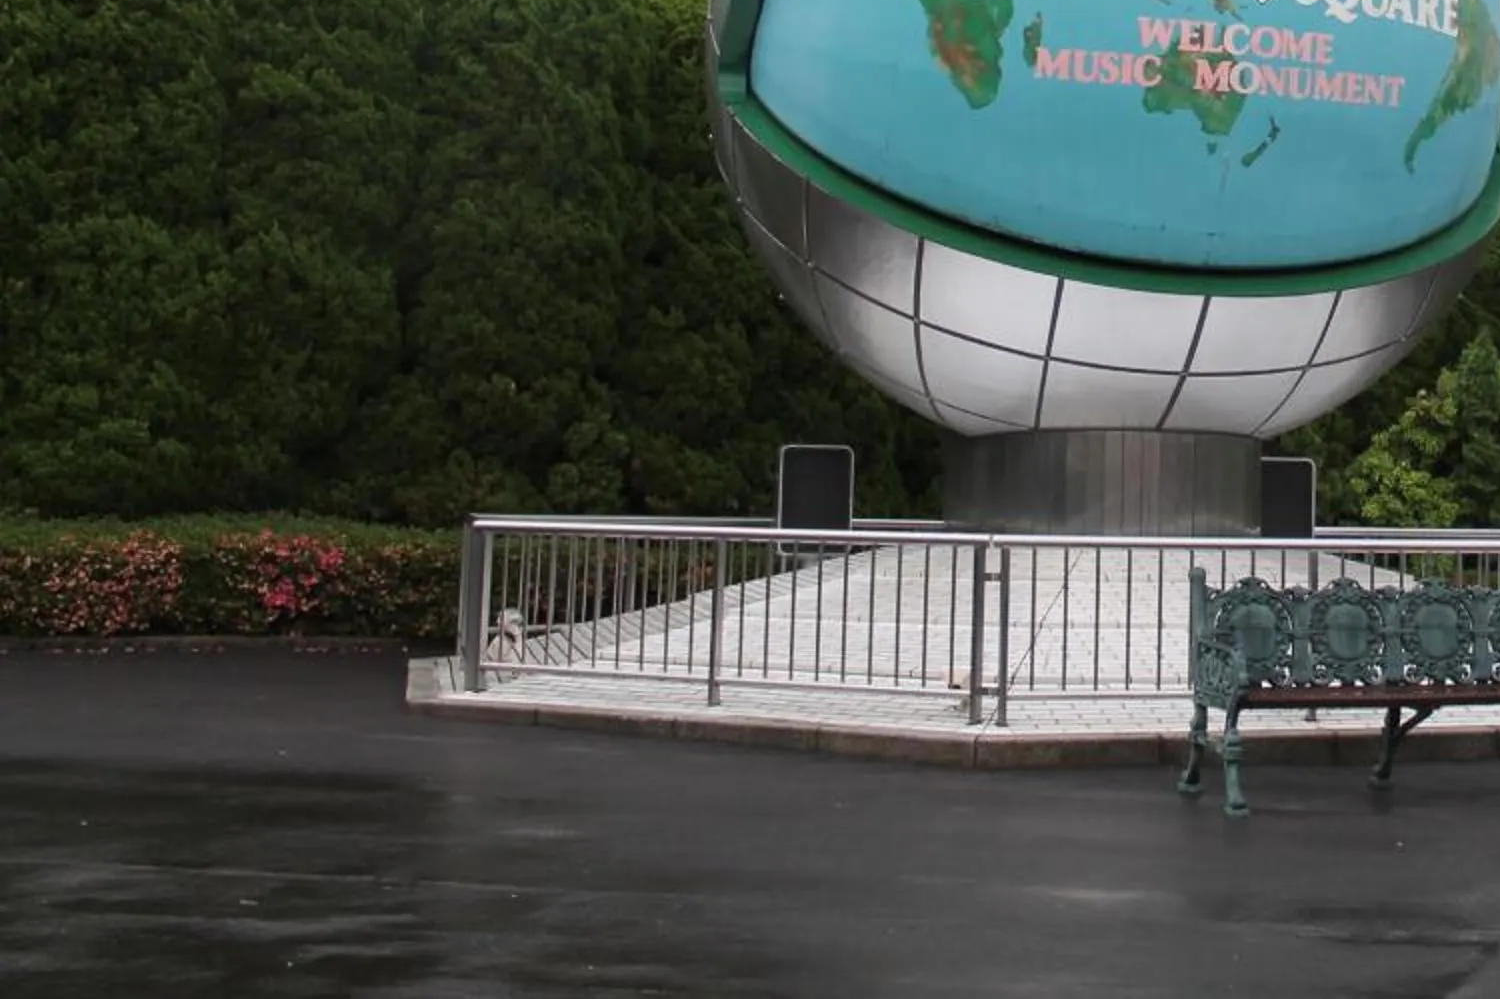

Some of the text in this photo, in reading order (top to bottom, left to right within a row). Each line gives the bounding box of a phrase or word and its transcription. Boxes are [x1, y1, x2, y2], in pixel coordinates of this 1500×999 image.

[1137, 16, 1335, 65] WELCOME
[1033, 46, 1406, 108] MUSIC MONUMENT
